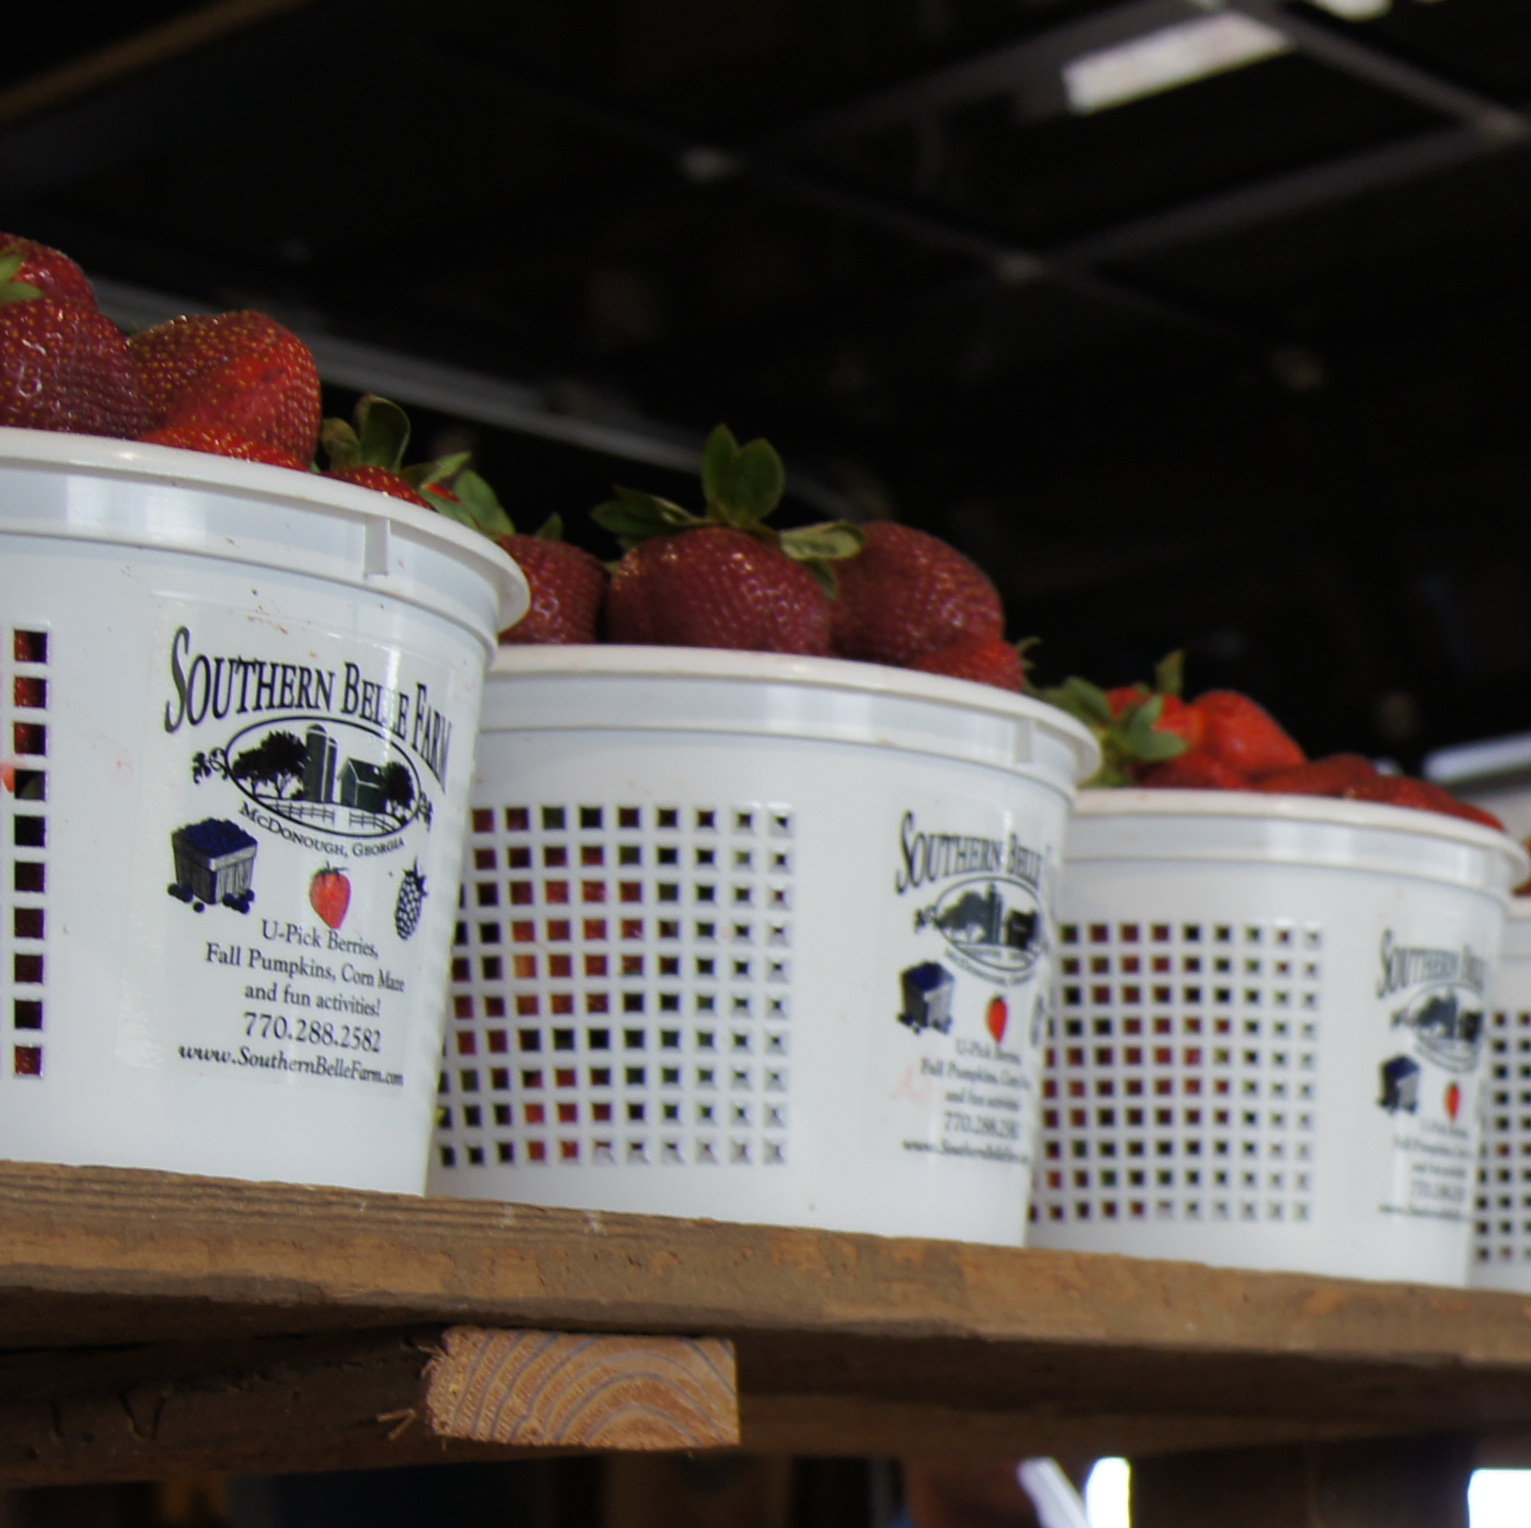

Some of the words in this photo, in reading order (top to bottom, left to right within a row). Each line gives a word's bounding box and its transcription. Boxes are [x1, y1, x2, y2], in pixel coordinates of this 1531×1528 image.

[164, 626, 335, 733] SOUTHERN
[261, 918, 322, 949] U-Pick
[205, 941, 241, 967] Fall
[247, 947, 337, 982] Pumpkins,
[341, 962, 375, 988] Corn
[244, 983, 278, 1003] and
[283, 984, 312, 1008] fun
[315, 993, 382, 1018] activities!
[243, 1010, 383, 1054] 770.288.2582
